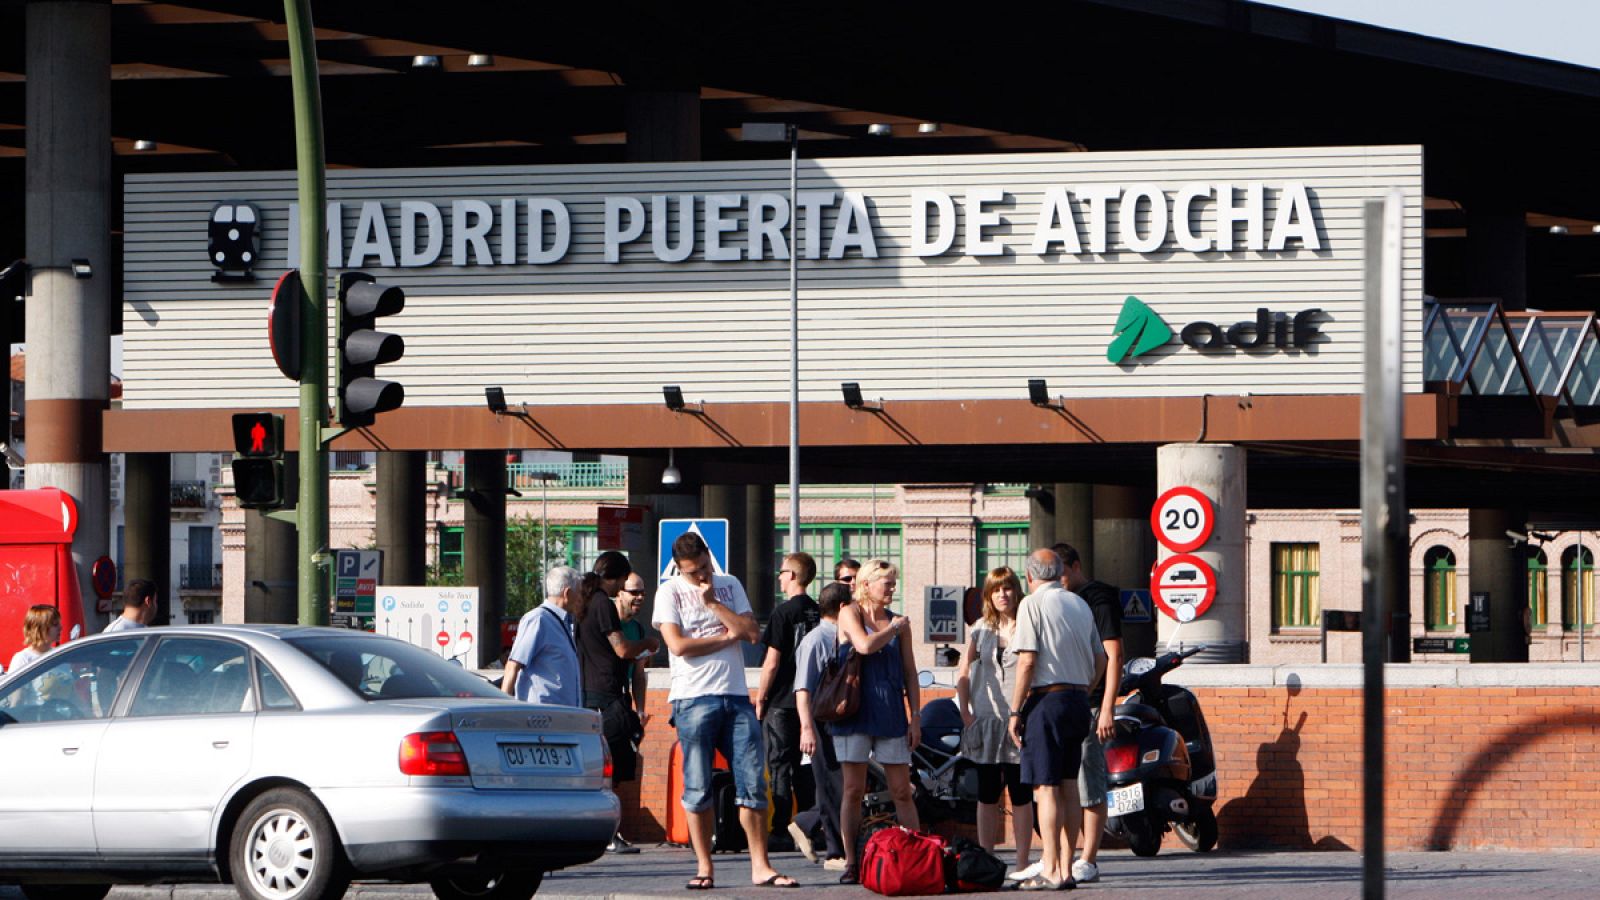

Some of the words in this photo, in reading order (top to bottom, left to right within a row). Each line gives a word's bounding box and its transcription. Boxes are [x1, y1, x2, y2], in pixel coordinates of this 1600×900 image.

[604, 191, 878, 263] PUERTA
[911, 187, 1004, 256] DE
[1032, 182, 1321, 254] ATOCHA
[1181, 308, 1322, 349] adif
[1166, 508, 1200, 530] 20
[343, 556, 355, 574] P
[1115, 786, 1142, 801] 3916
